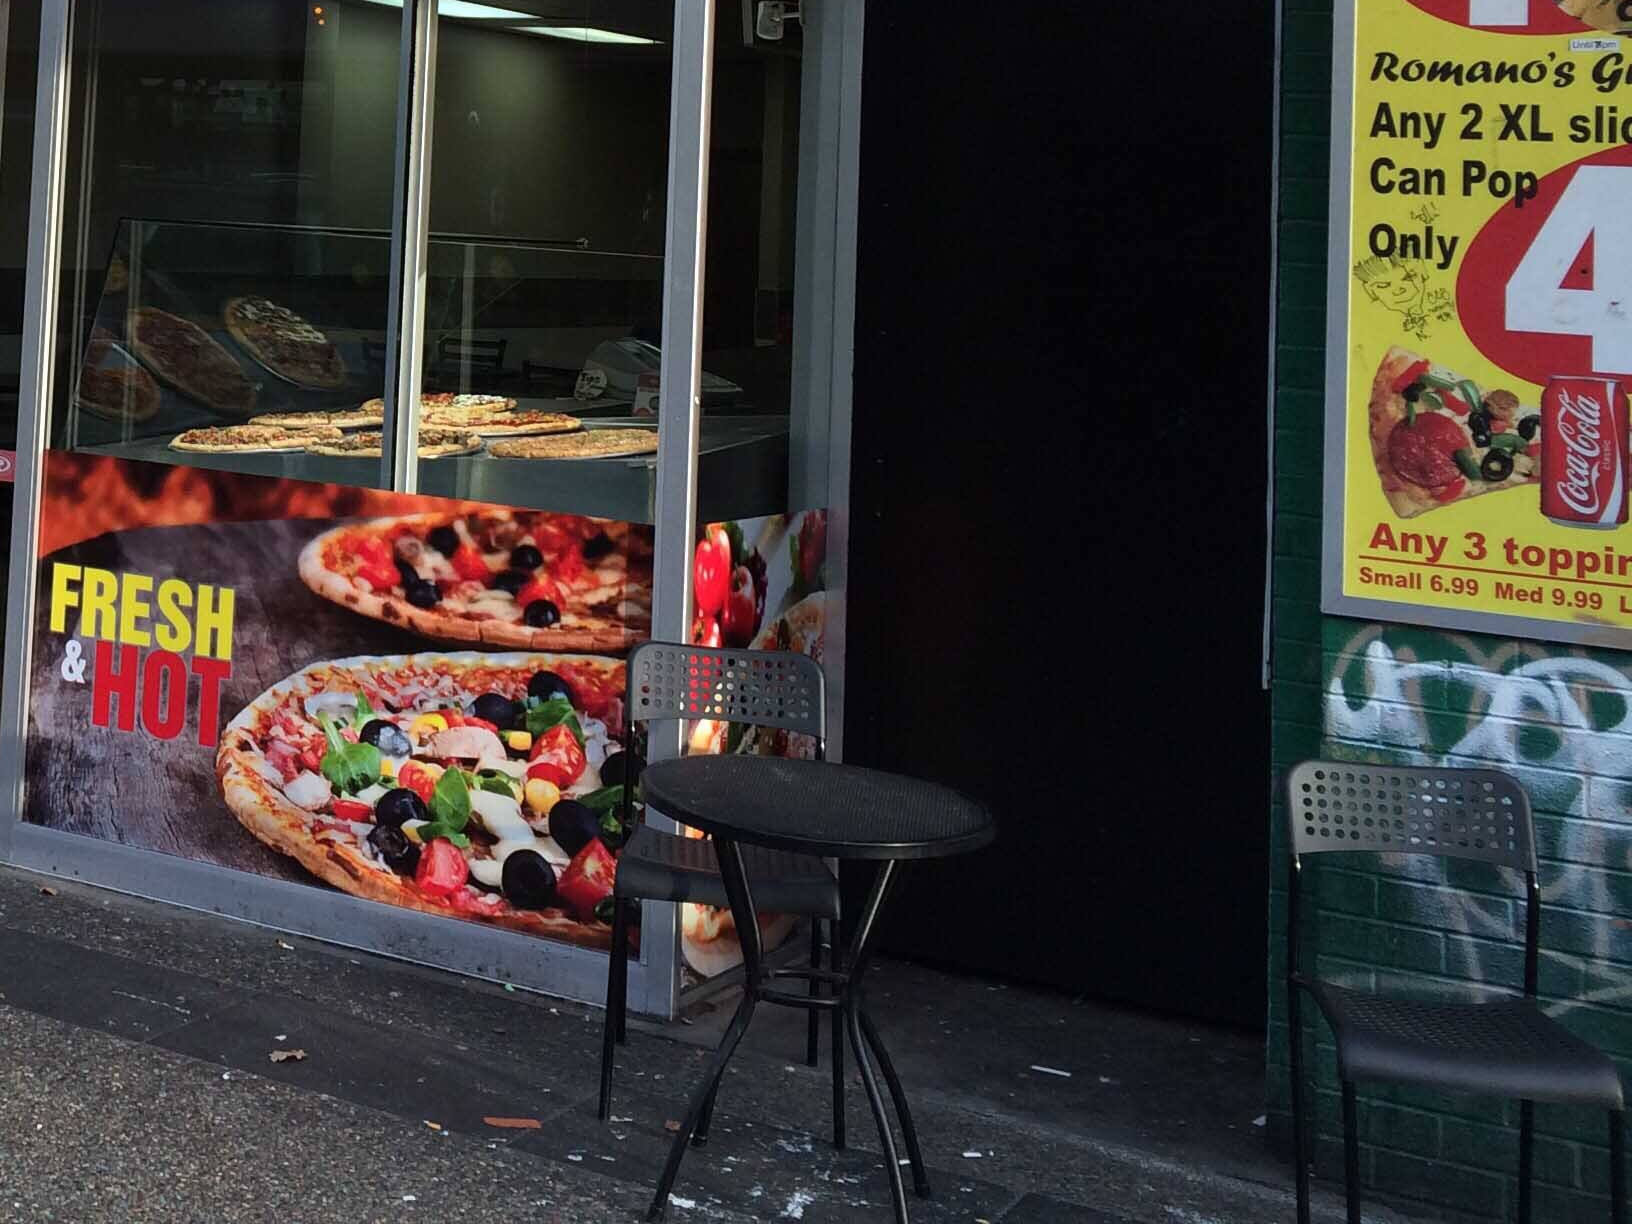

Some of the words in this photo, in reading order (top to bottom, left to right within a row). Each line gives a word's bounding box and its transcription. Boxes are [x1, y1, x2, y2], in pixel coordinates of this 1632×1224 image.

[1371, 51, 1575, 88] Romano's
[1370, 102, 1445, 149] Any
[1460, 103, 1483, 140] 2
[1499, 104, 1553, 142] XL
[1370, 157, 1446, 196] Can
[1462, 160, 1538, 208] Pop
[1369, 224, 1460, 270] Only
[1369, 522, 1448, 564] Any
[1464, 532, 1487, 560] 3
[50, 562, 235, 661] FRESH
[1359, 566, 1422, 592] Small
[1430, 574, 1479, 597] 6.99
[1495, 582, 1543, 604] Med
[1552, 588, 1603, 611] 9.99
[61, 640, 86, 684] &
[92, 640, 231, 748] HOT
